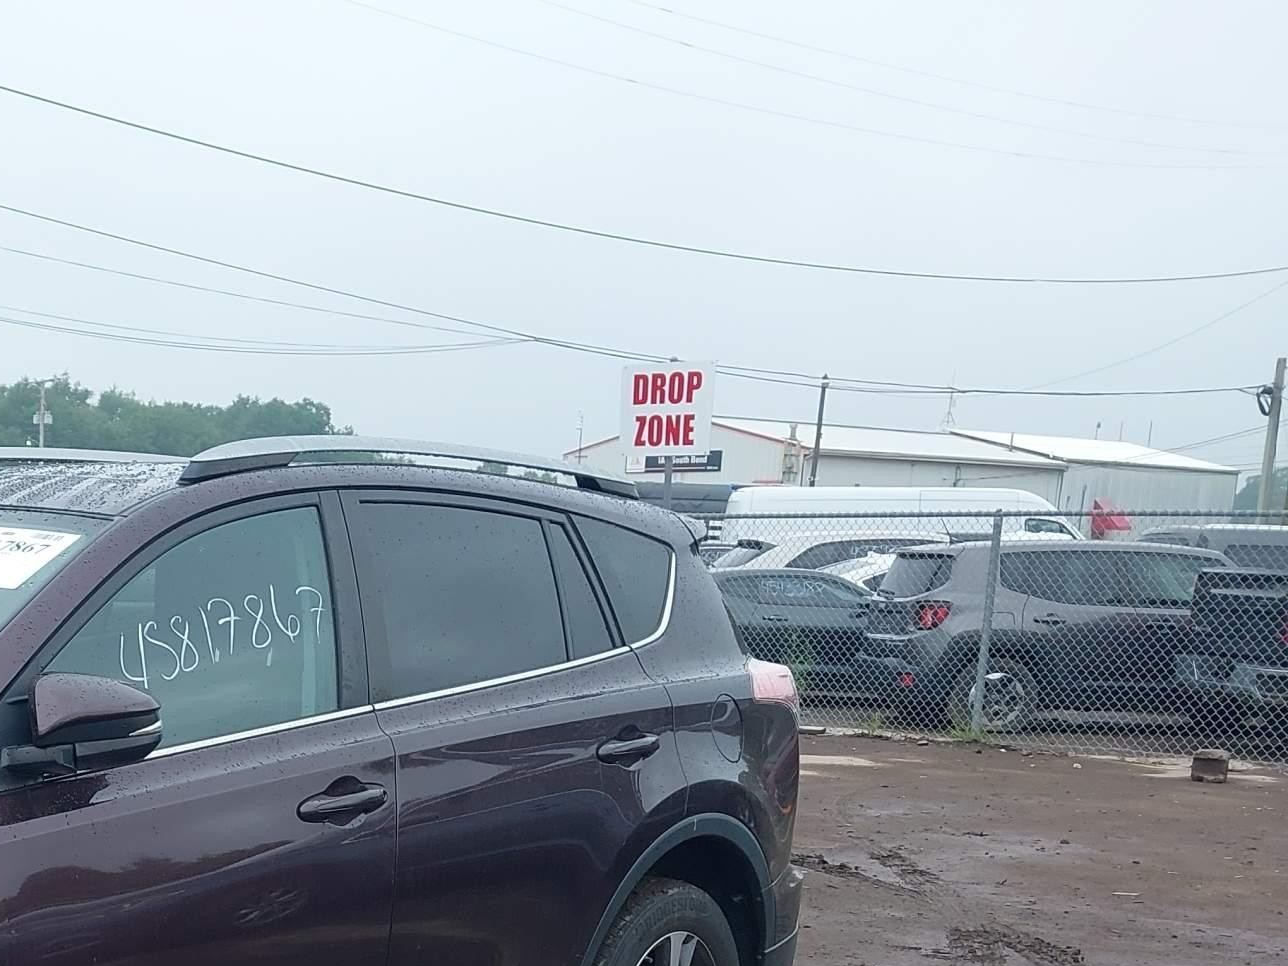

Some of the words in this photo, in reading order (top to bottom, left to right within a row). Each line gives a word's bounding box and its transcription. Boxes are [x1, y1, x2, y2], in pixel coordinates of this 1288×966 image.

[633, 371, 702, 405] DROP
[634, 415, 694, 446] ZONE
[119, 584, 325, 689] 45817867
